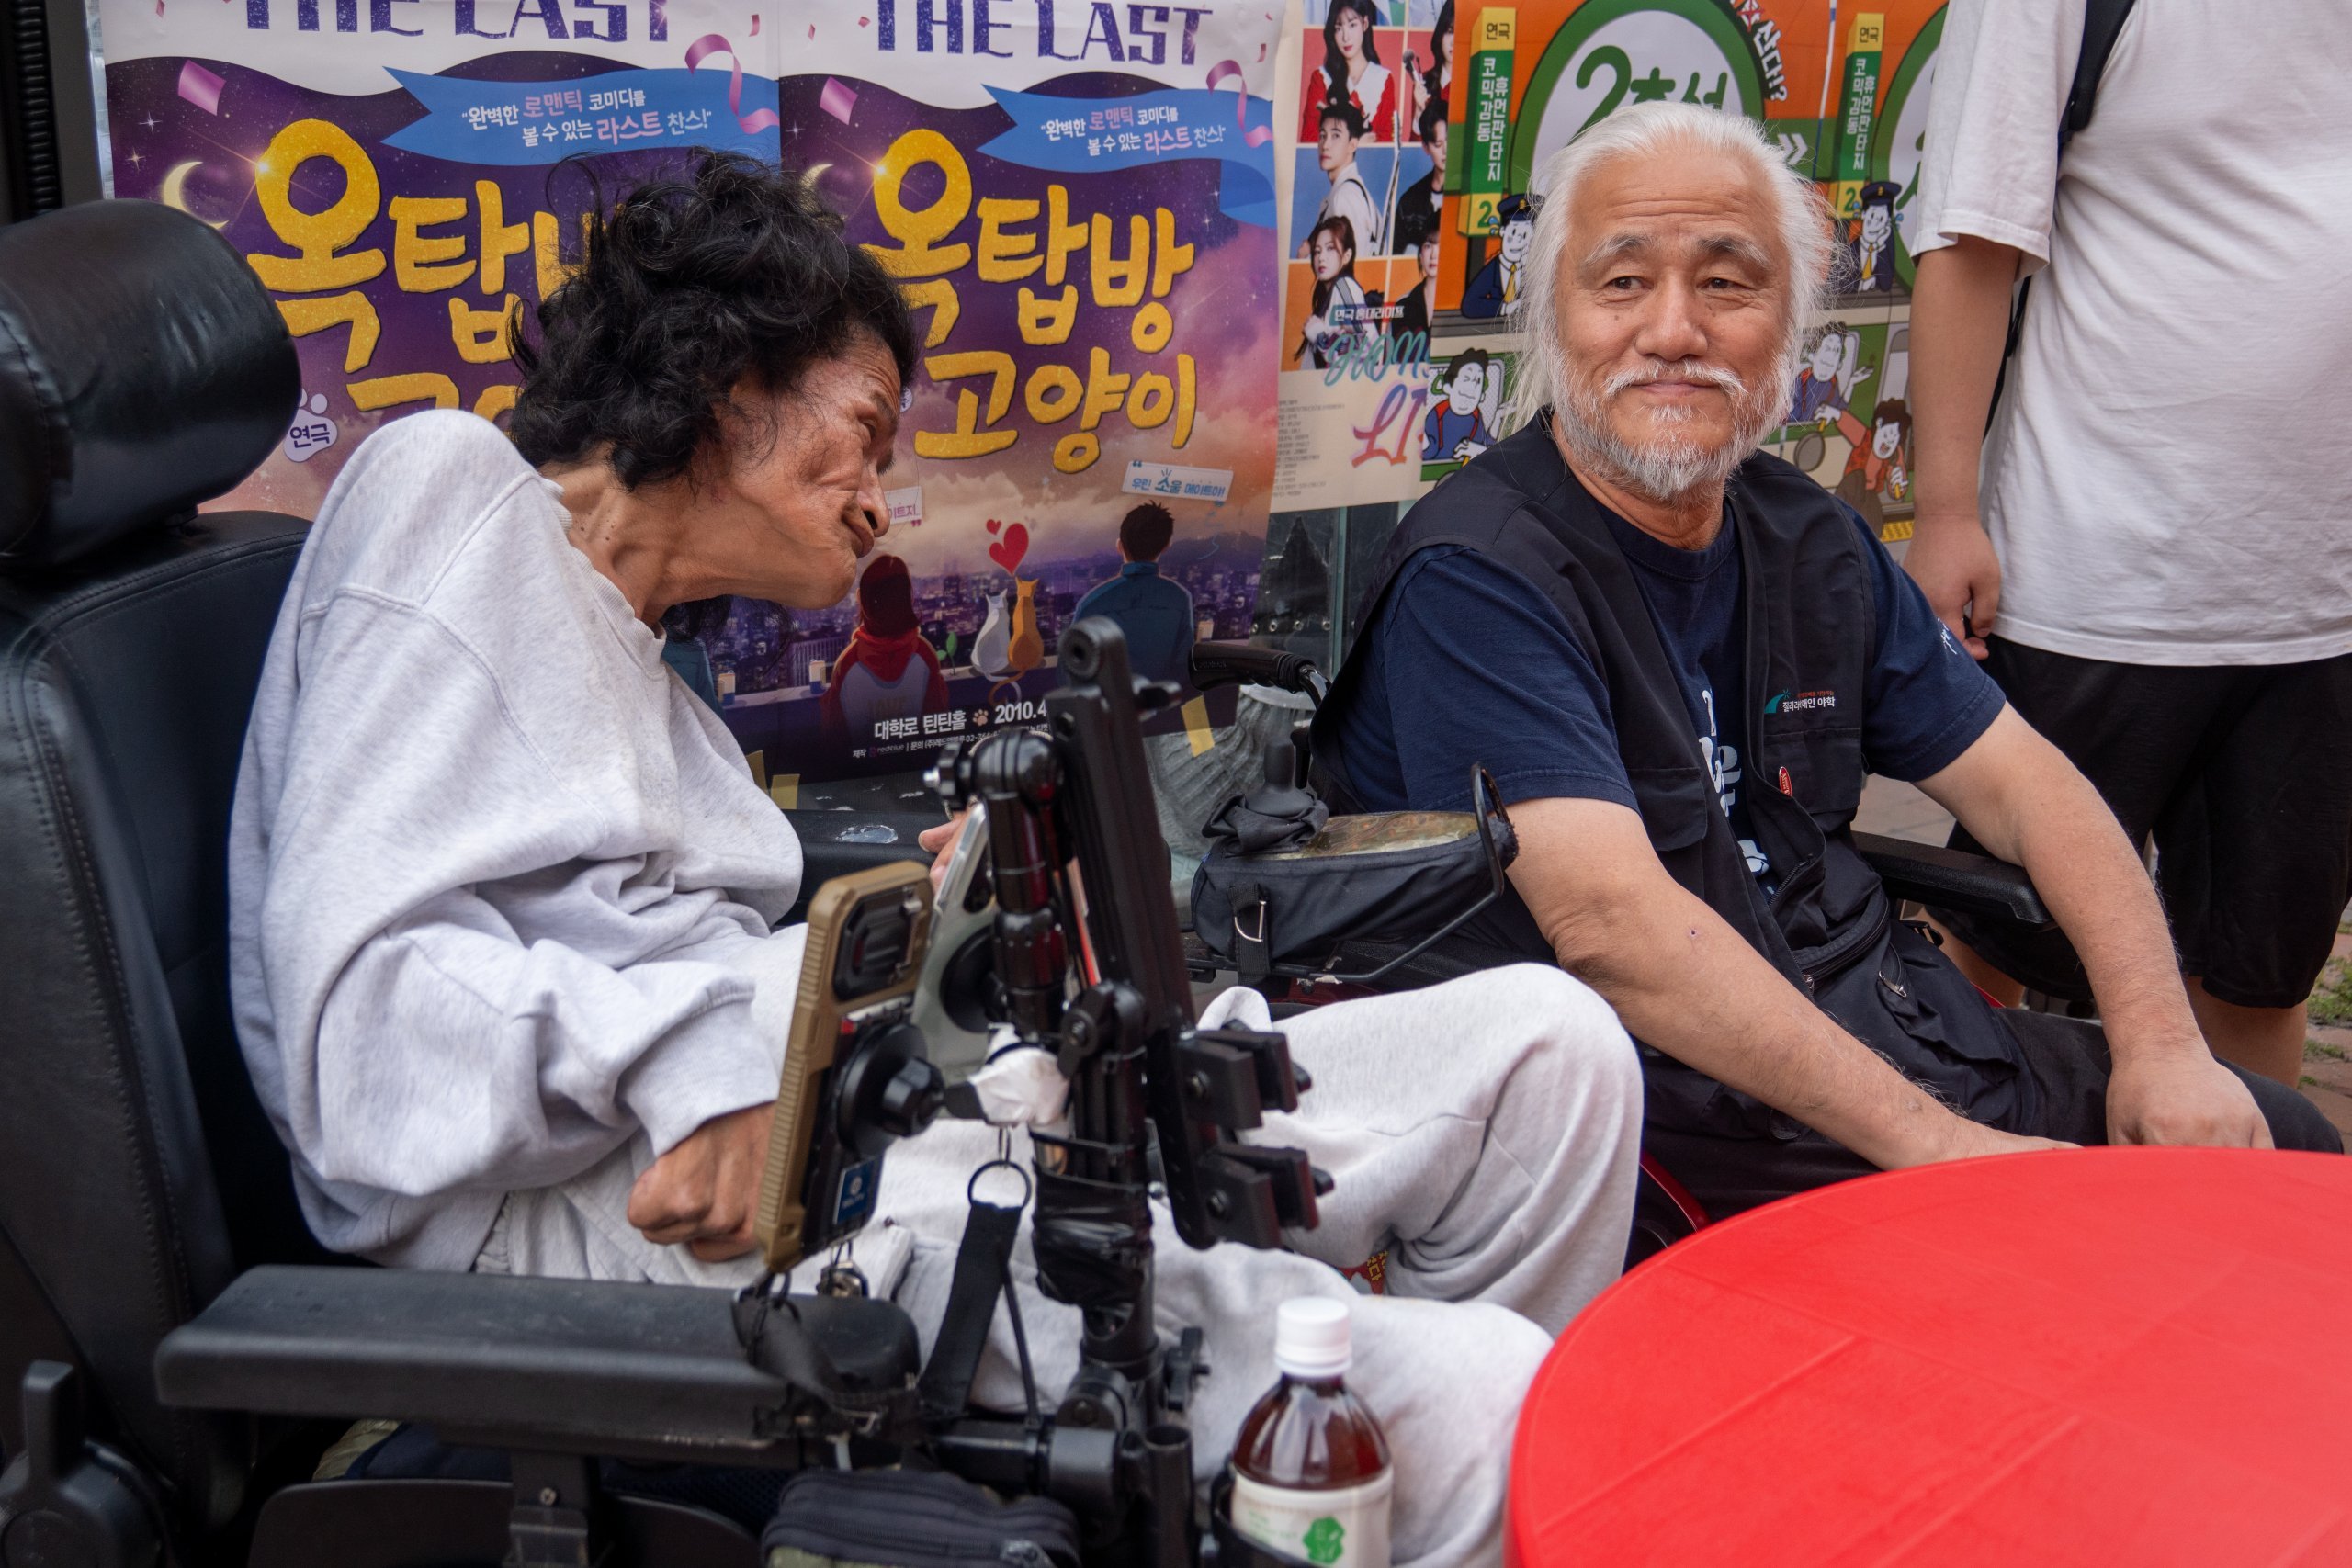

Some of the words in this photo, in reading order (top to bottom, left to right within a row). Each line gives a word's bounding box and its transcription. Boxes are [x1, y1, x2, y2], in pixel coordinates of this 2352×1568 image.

[877, 0, 1013, 58] THE
[1035, 0, 1213, 65] LAST
[1486, 22, 1510, 40] 연극
[1860, 27, 1879, 43] 연극
[523, 89, 582, 118] 로맨틱
[589, 88, 646, 111] 코미디를
[522, 126, 539, 147] 볼
[542, 123, 559, 142] 수
[561, 119, 593, 141] 있는
[596, 111, 663, 145] 라스트
[1089, 106, 1134, 130] 로맨틱
[1137, 106, 1178, 126] 코미디를
[1087, 138, 1101, 156] 볼
[1103, 135, 1116, 152] 수
[1119, 133, 1141, 152] 있는
[1144, 126, 1193, 156] 라스트
[247, 118, 625, 373] 옥탑
[858, 129, 1194, 353] 옥탑방
[1334, 308, 1354, 321] 연극
[915, 346, 1195, 474] 고양이
[290, 423, 330, 448] 연극
[1132, 478, 1152, 491] 우린
[1155, 476, 1182, 494] 소울
[1817, 696, 1836, 707] 야학
[875, 717, 919, 740] 대학로
[923, 710, 967, 734] 틴틴홀
[910, 741, 924, 751] 문의
